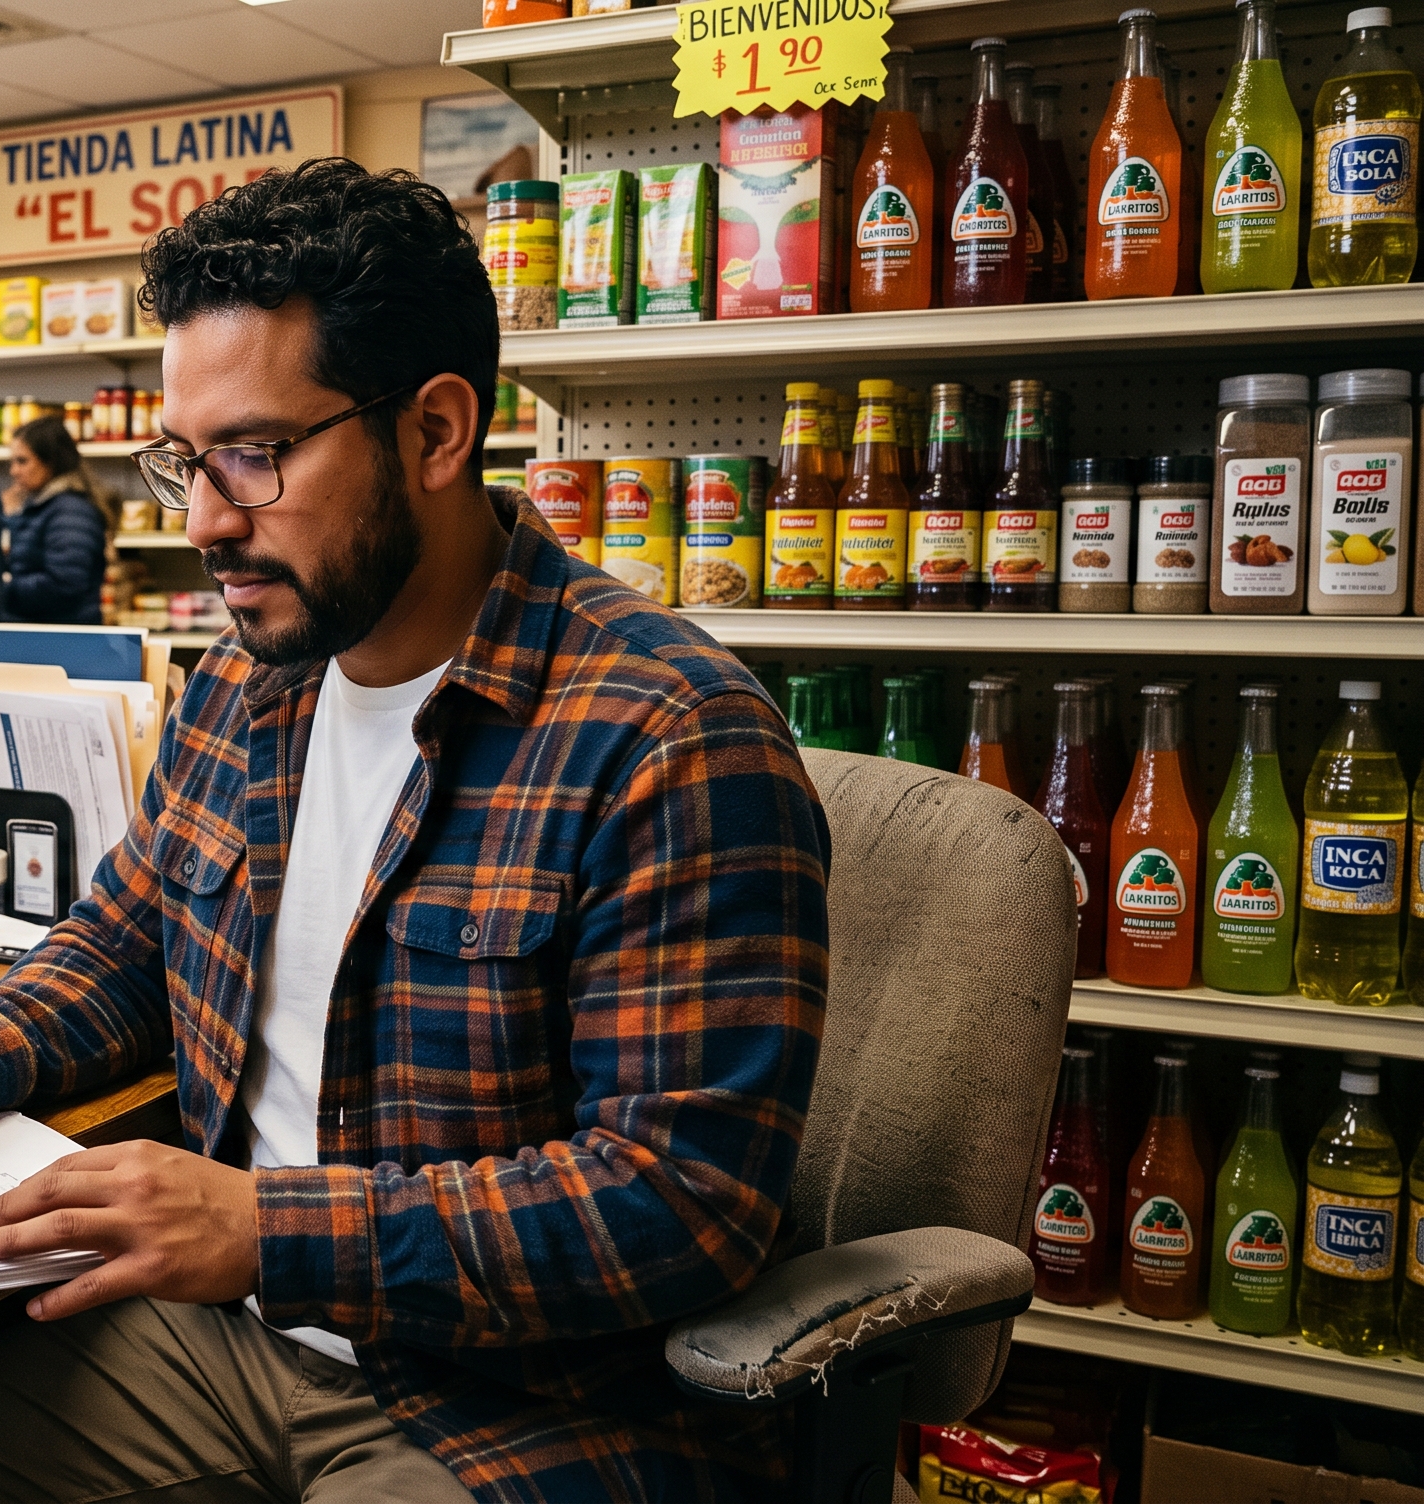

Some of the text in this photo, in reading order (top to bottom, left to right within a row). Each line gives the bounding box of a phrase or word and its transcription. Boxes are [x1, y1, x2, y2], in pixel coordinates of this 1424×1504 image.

[2, 109, 294, 185] TIENDA LATINA
[1325, 847, 1385, 866] INCA
[1329, 865, 1382, 880] KOLA
